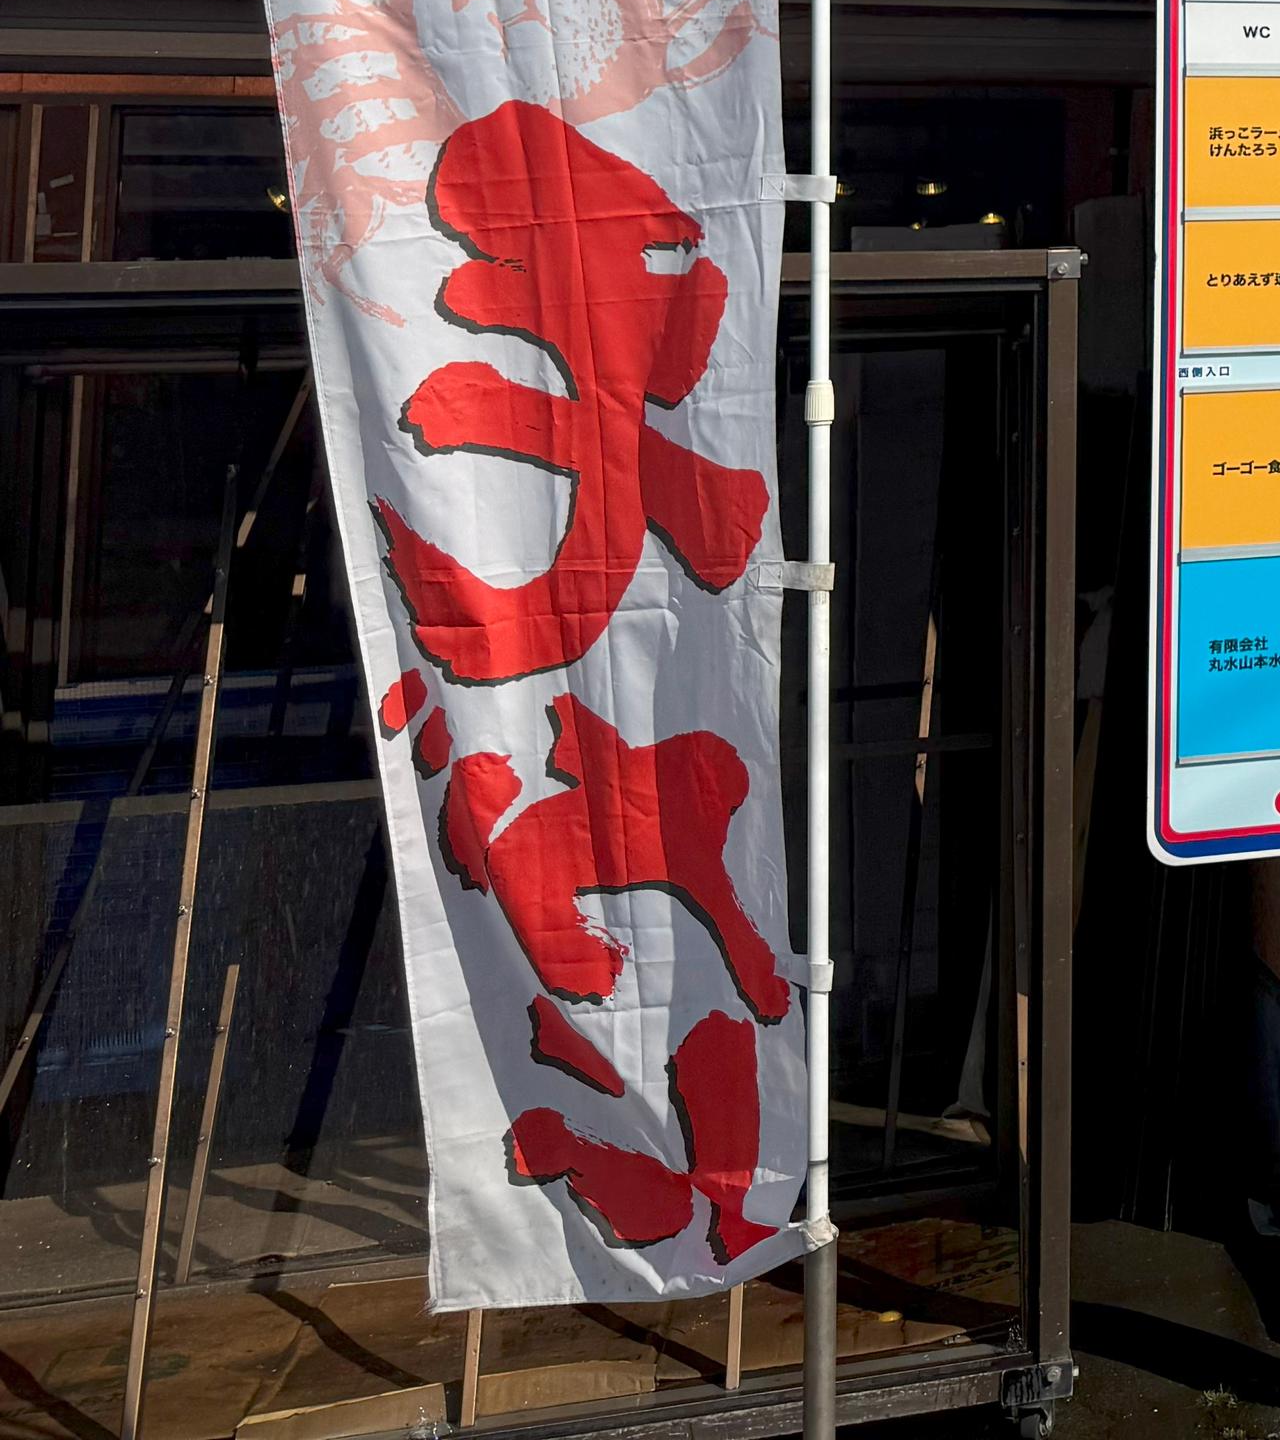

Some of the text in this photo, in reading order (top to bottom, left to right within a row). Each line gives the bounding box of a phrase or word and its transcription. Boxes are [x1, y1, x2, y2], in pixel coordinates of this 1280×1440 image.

[1243, 26, 1271, 39] WC
[1209, 143, 1278, 157] けんたろう
[1178, 366, 1230, 378] 西側入口
[1209, 636, 1268, 653] 有限会社
